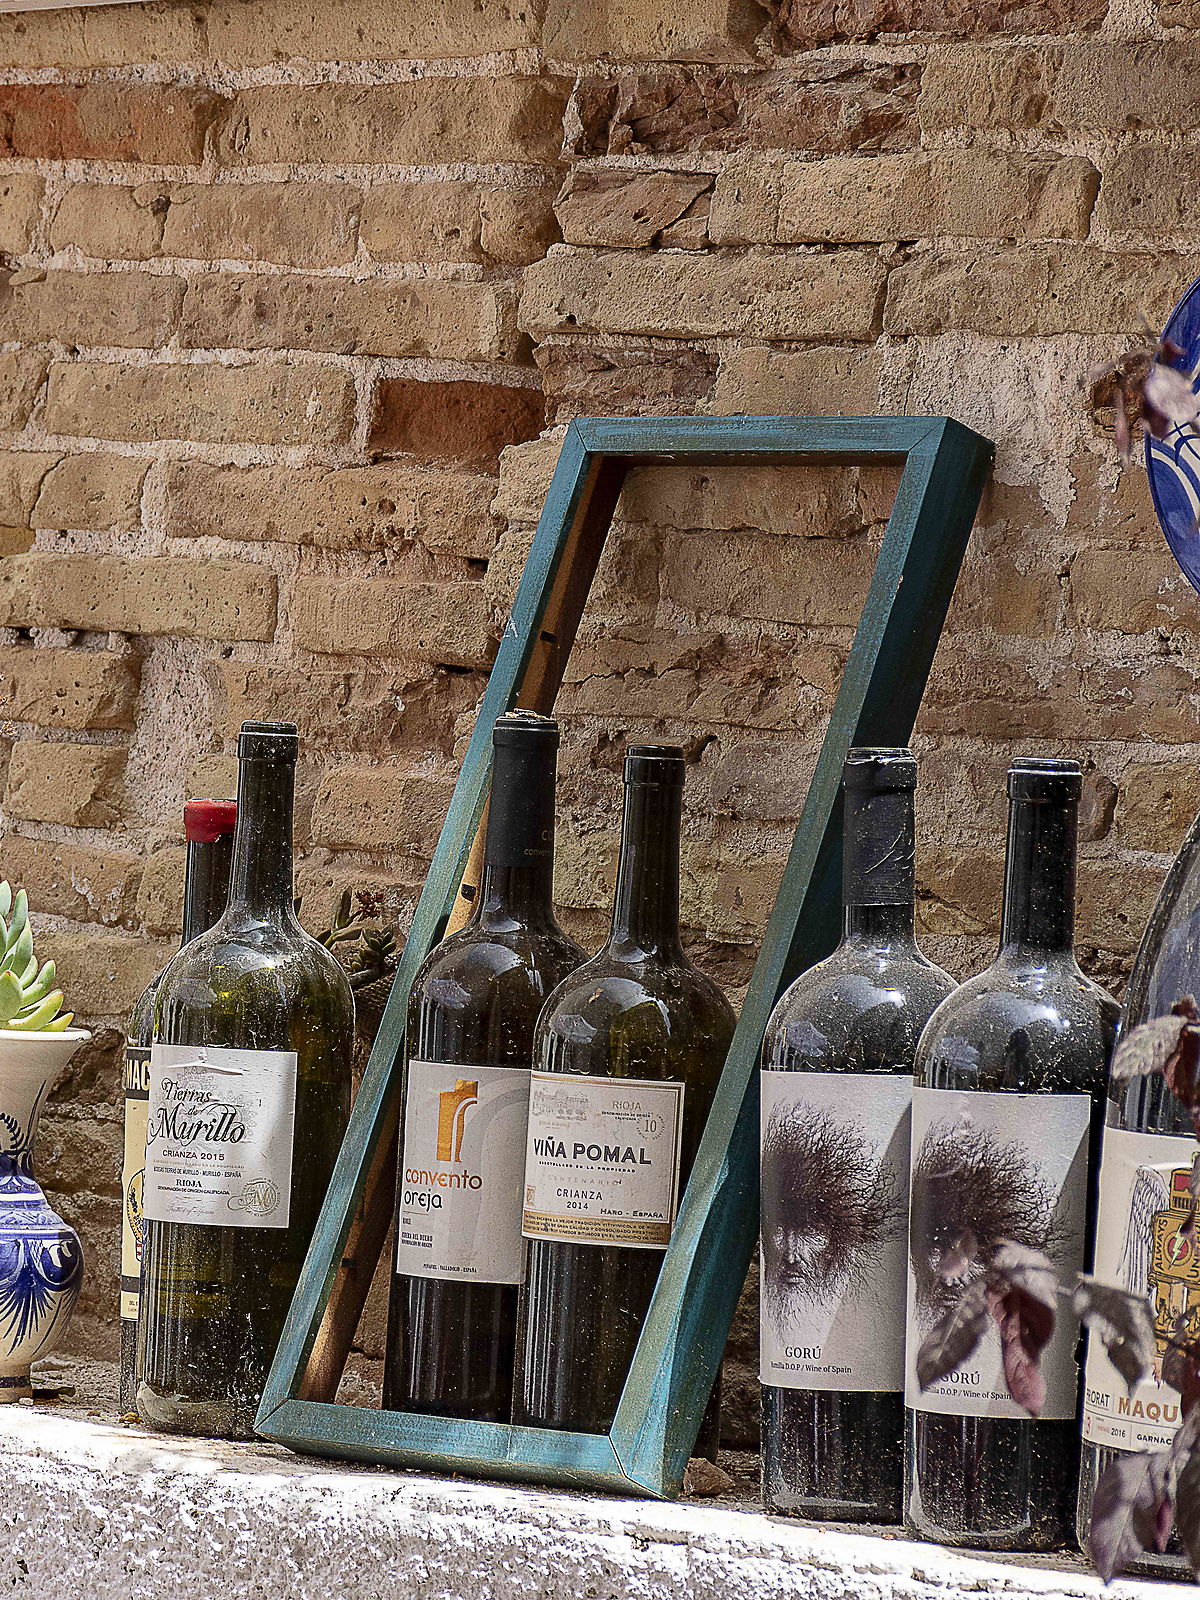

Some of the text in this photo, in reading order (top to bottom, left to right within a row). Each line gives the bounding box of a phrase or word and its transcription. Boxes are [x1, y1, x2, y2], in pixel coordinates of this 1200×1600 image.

[161, 1077, 212, 1102] Tierras
[612, 1100, 642, 1111] RIOJA
[147, 1102, 245, 1147] Murillo
[644, 1119, 657, 1133] 10
[162, 1149, 225, 1161] CRIANZA 2015
[534, 1136, 652, 1165] VIÑA POMAL
[224, 1170, 242, 1178] ESPAÑA
[405, 1168, 483, 1190] convento
[176, 1179, 202, 1188] RIOJA
[404, 1188, 442, 1212] oreja
[556, 1188, 603, 1201] CRIANZA
[566, 1201, 589, 1210] 2014
[600, 1208, 623, 1216] HARO
[632, 1210, 664, 1219] ESPAÑA
[1157, 1219, 1168, 1271] ALWAYS
[785, 1346, 822, 1360] GORÚ
[805, 1364, 822, 1372] Wine
[823, 1364, 831, 1373] of
[831, 1365, 852, 1375] Spain
[963, 1389, 980, 1398] Wine
[981, 1391, 990, 1399] of
[990, 1391, 1012, 1401] Spain
[1118, 1396, 1179, 1423] MAQU
[1111, 1427, 1126, 1438] 2016
